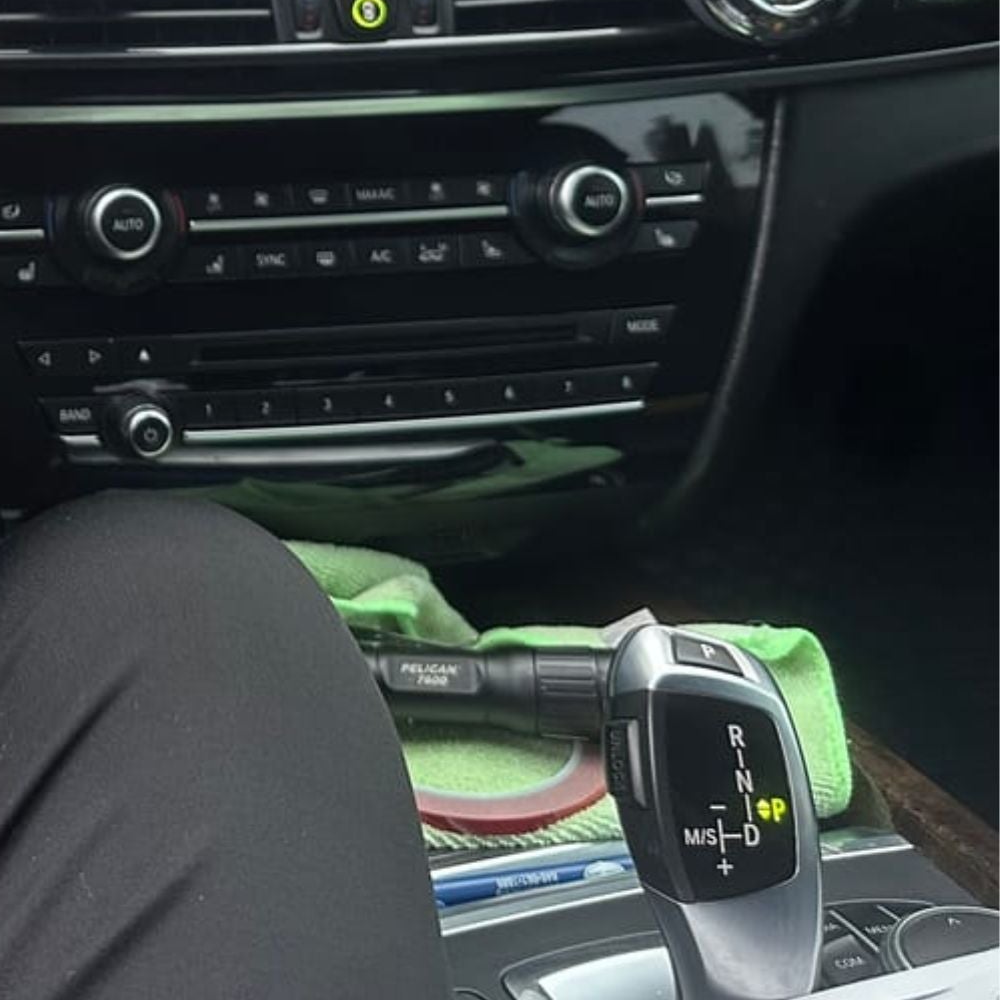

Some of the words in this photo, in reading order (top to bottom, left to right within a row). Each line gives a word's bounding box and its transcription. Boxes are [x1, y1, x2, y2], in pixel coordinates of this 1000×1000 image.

[585, 194, 614, 208] AUTO
[111, 218, 144, 232] AUTO
[255, 253, 286, 267] SYNC
[370, 249, 392, 263] A/C
[59, 407, 91, 422] BAND
[700, 643, 716, 660] P
[400, 662, 458, 675] PELICAN
[727, 723, 746, 748] R
[735, 769, 755, 794] N
[770, 797, 787, 823] P
[684, 827, 718, 846] M/S
[744, 823, 761, 847] D
